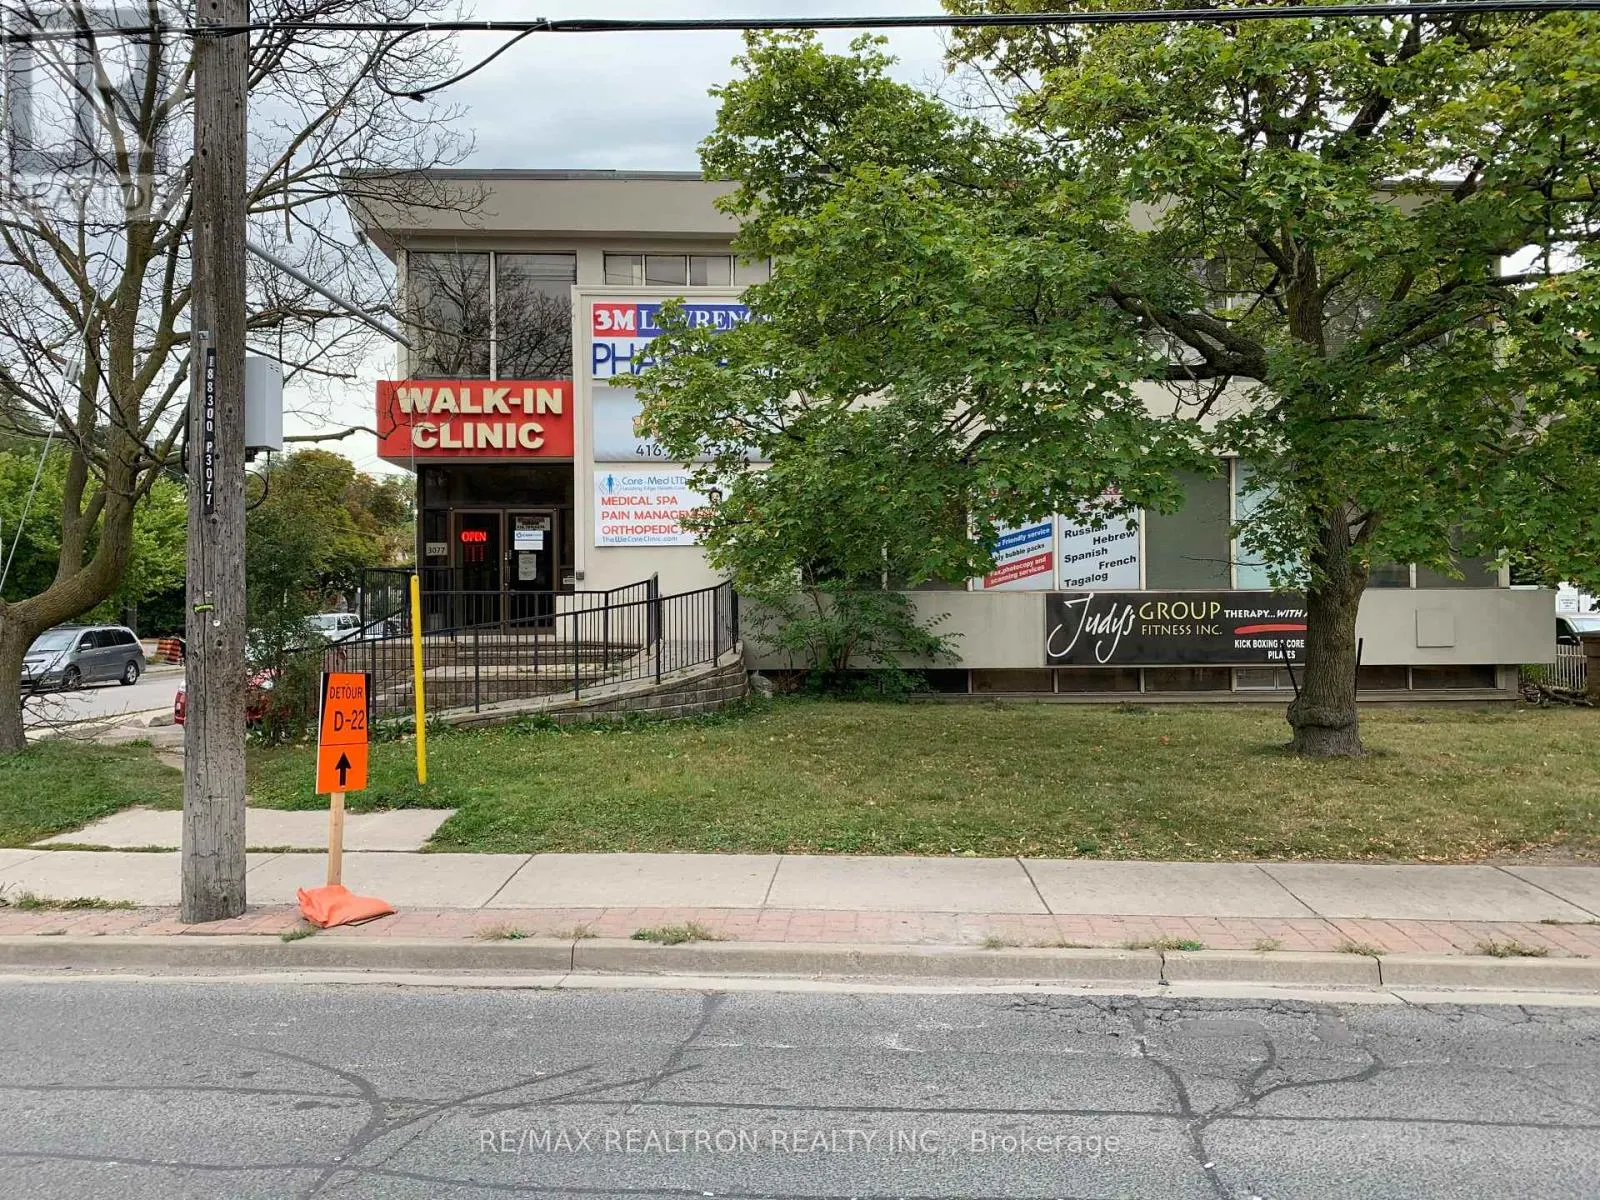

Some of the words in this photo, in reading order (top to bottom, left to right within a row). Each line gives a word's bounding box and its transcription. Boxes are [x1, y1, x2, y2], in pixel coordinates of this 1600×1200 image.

[594, 309, 636, 331] 3M
[396, 387, 563, 415] WALK-IN
[411, 422, 545, 449] CLINIC
[601, 495, 653, 506] MEDICAL
[656, 495, 678, 505] SPA
[601, 511, 630, 520] PAIN
[461, 530, 487, 542] OPEN
[601, 524, 679, 535] ORTHOPEDIC
[1001, 534, 1027, 546] Friendly
[1028, 528, 1051, 539] service
[1093, 530, 1136, 546] Hebrew
[427, 546, 446, 555] 3077
[1005, 548, 1026, 559] bubble
[1027, 543, 1045, 555] packs
[1064, 547, 1108, 564] Spanish
[1034, 556, 1047, 565] and
[1098, 555, 1137, 570] French
[1019, 564, 1045, 577] services
[1064, 572, 1109, 588] Tagalog
[1047, 592, 1136, 663] Judy's
[1139, 601, 1221, 620] GROUP
[1142, 624, 1192, 635] FITNESS
[1196, 624, 1223, 635] INC.
[1234, 639, 1251, 649] KICK
[1252, 639, 1278, 649] BOXING
[1286, 639, 1305, 649] CORE
[1267, 650, 1296, 660] PILAES
[329, 686, 363, 700] DETOUR
[334, 710, 365, 732] D-22
